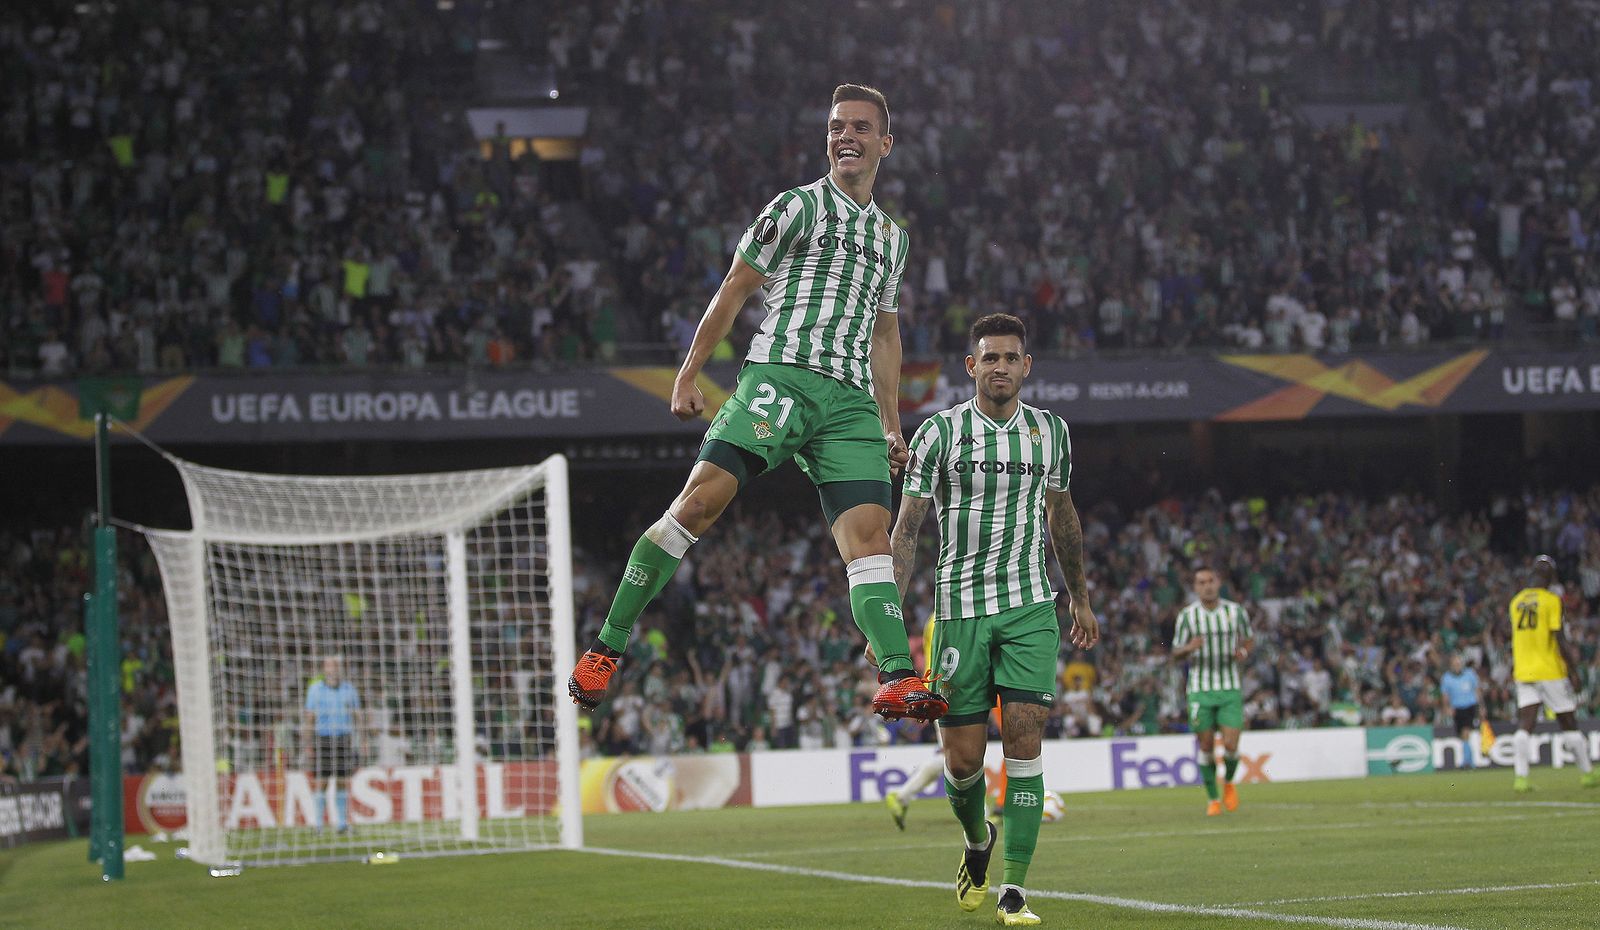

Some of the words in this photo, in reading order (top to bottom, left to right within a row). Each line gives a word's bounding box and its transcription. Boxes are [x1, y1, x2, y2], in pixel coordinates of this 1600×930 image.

[1089, 381, 1189, 399] RENT-A-CAR
[1502, 366, 1585, 394] UEFA
[211, 393, 301, 423] UEFA
[309, 391, 441, 421] EUROPA
[449, 388, 579, 419] LEAGUE
[747, 382, 795, 430] 21
[953, 460, 1046, 478] OTCDESKS
[1517, 601, 1538, 631] 26
[941, 646, 960, 682] 9
